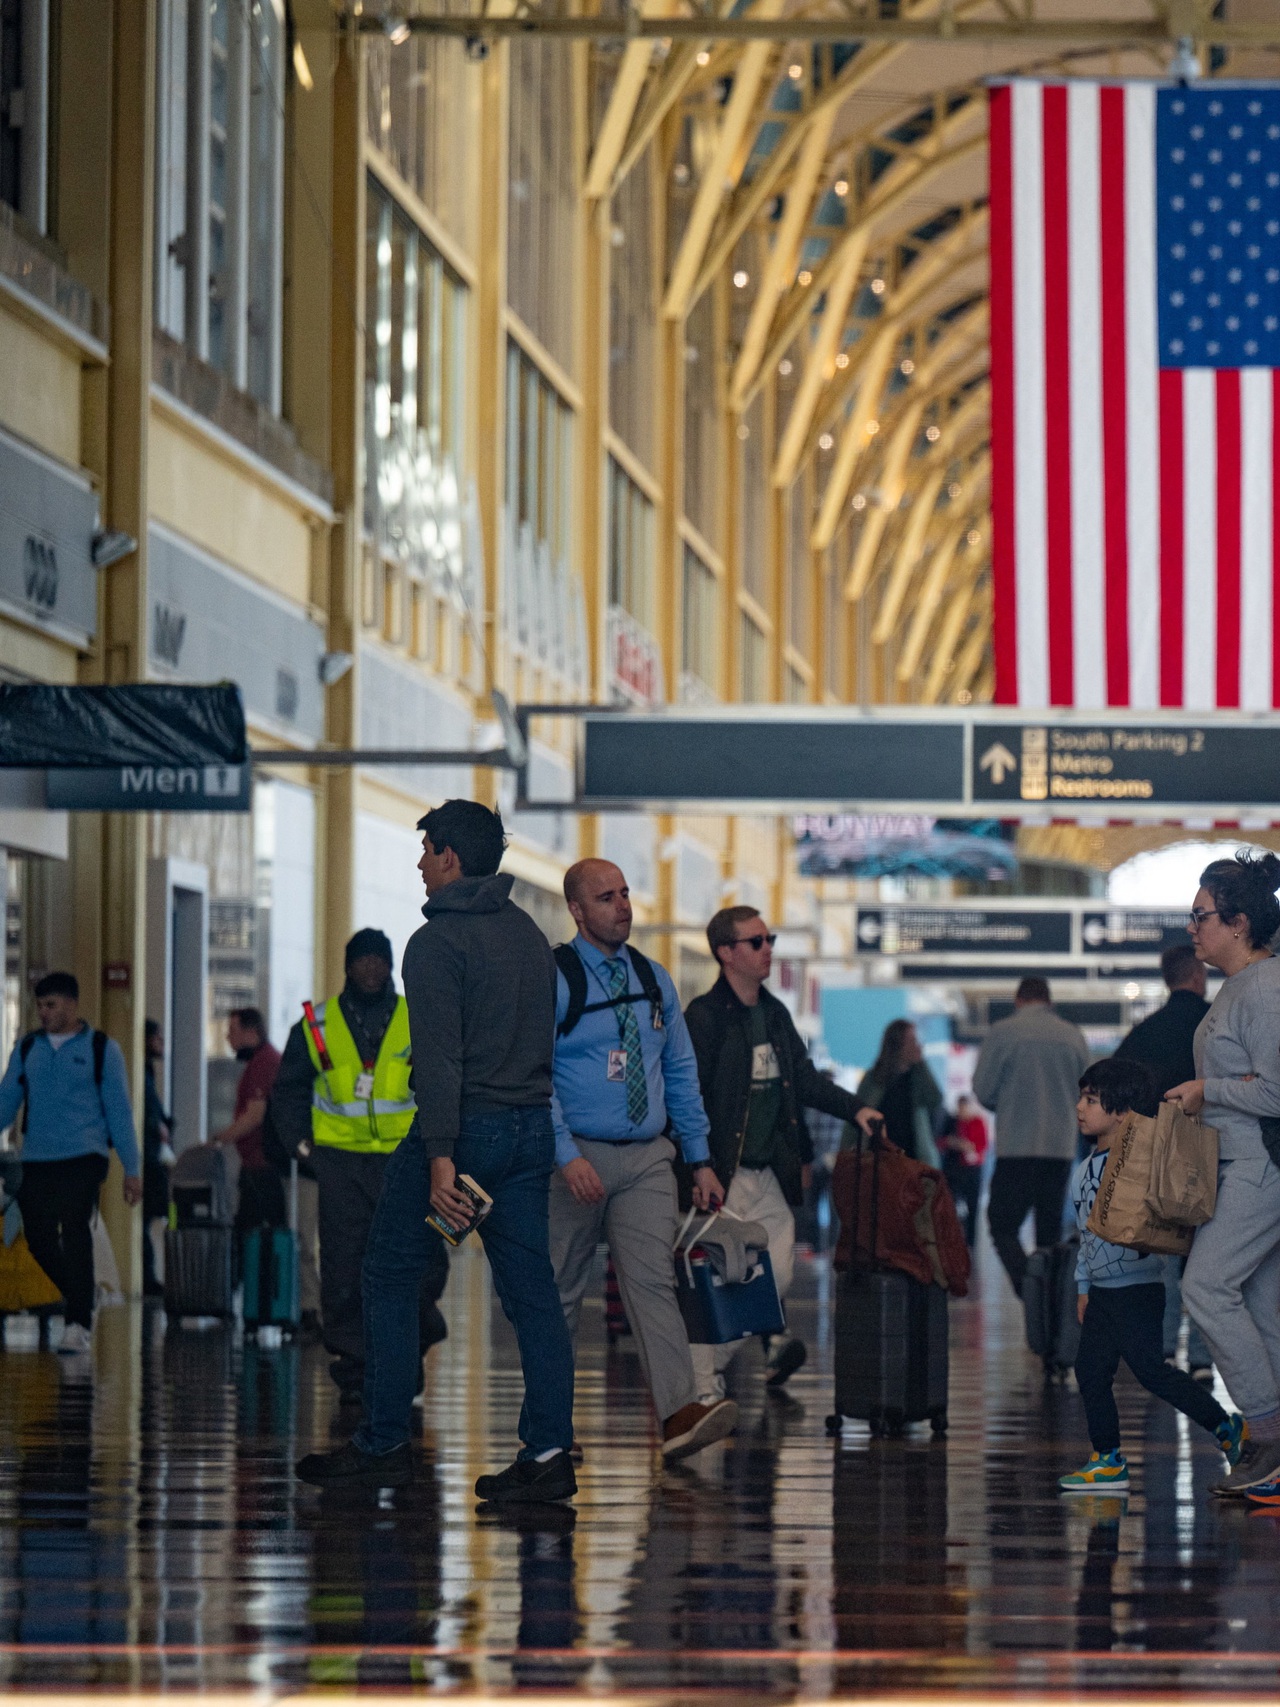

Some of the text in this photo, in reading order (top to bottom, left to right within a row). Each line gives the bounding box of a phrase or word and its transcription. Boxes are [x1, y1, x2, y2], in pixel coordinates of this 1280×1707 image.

[1051, 729, 1109, 751] South
[1112, 729, 1188, 756] Parking
[1050, 752, 1114, 774] Metro
[121, 765, 199, 794] Men
[1050, 775, 1154, 798] Restrooms
[1100, 1180, 1117, 1227] Paradies
